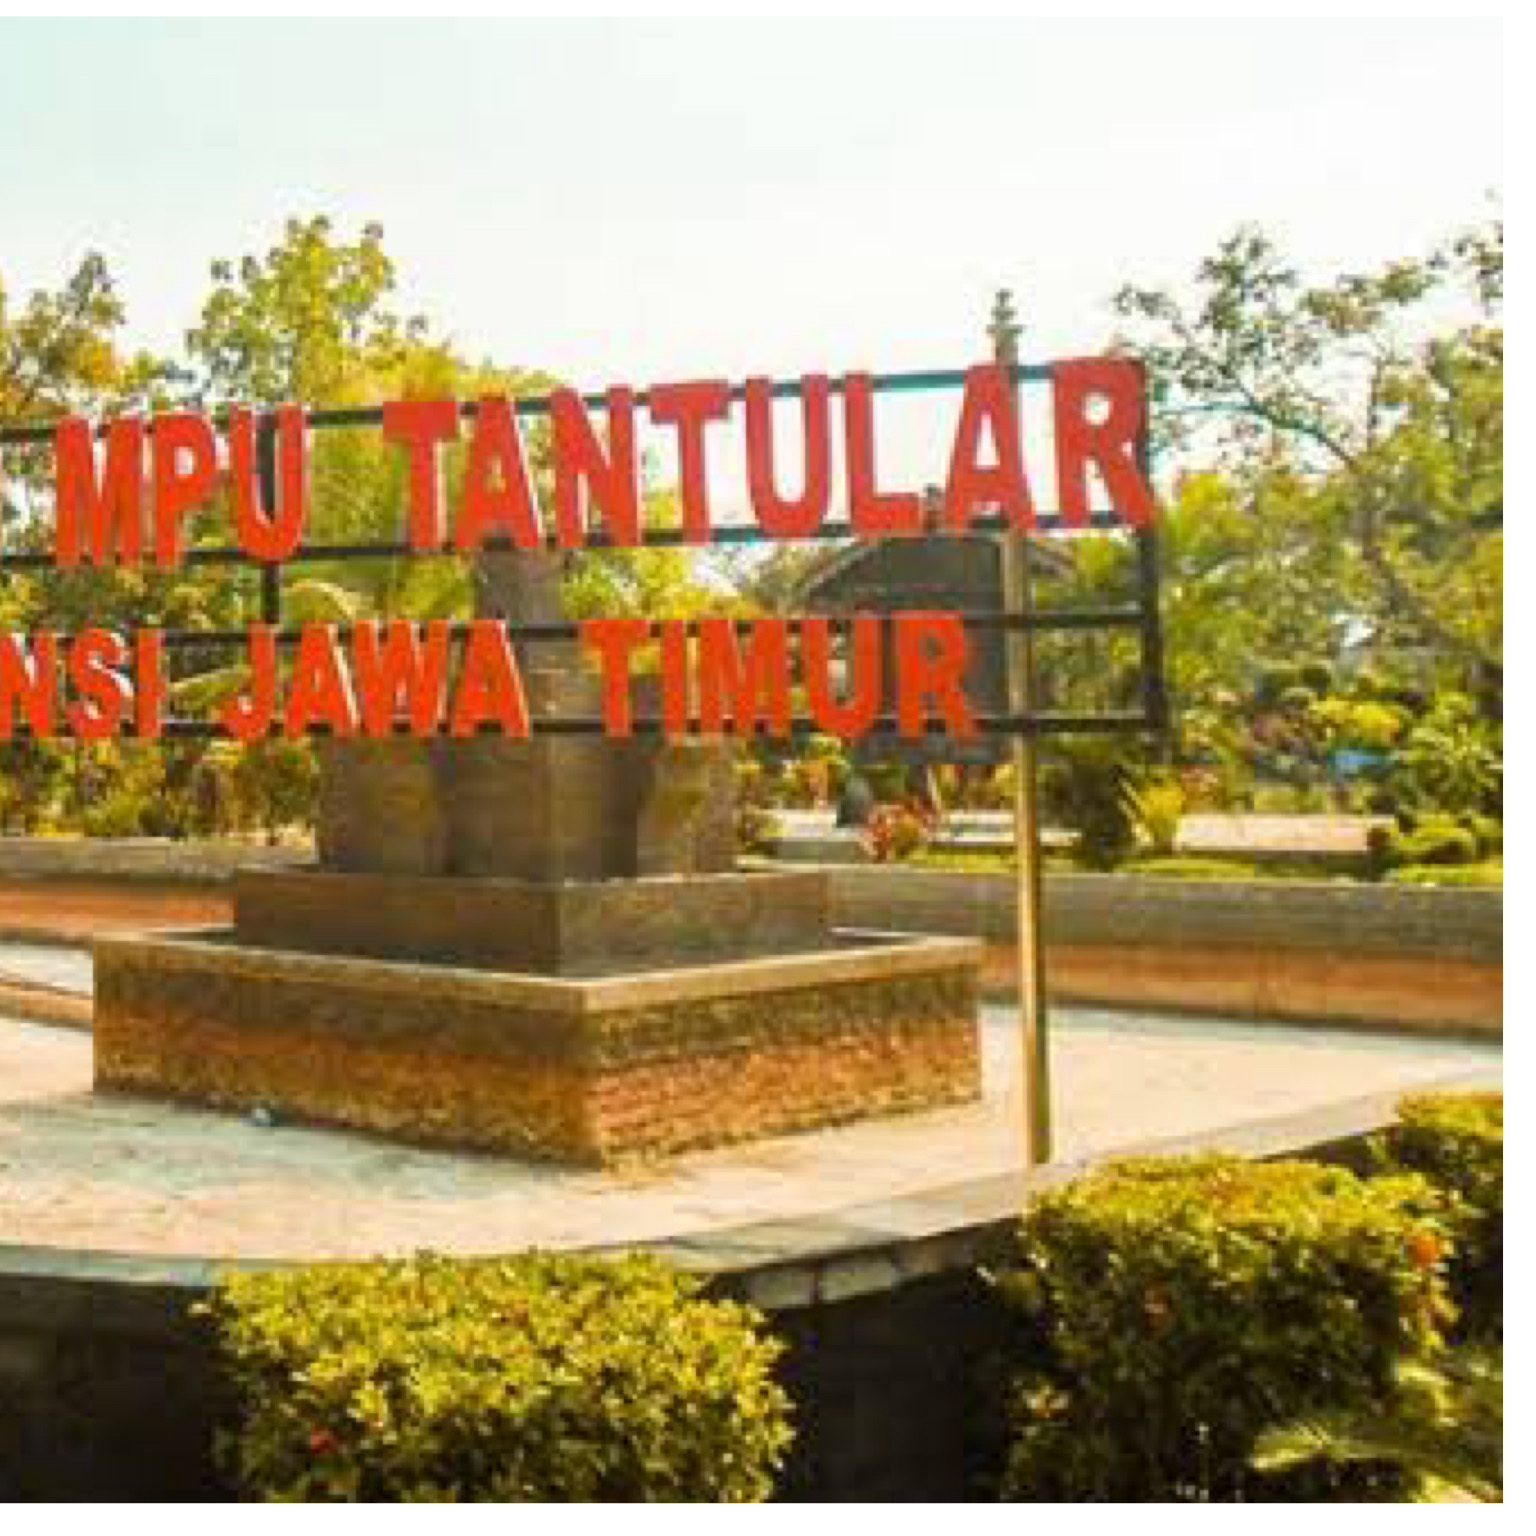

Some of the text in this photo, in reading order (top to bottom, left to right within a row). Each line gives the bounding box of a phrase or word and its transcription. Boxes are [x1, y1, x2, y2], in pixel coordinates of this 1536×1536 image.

[54, 410, 306, 568] MPU
[382, 359, 1154, 549] TANTULAR
[220, 618, 530, 745] JAWA
[581, 610, 980, 741] TIMUR
